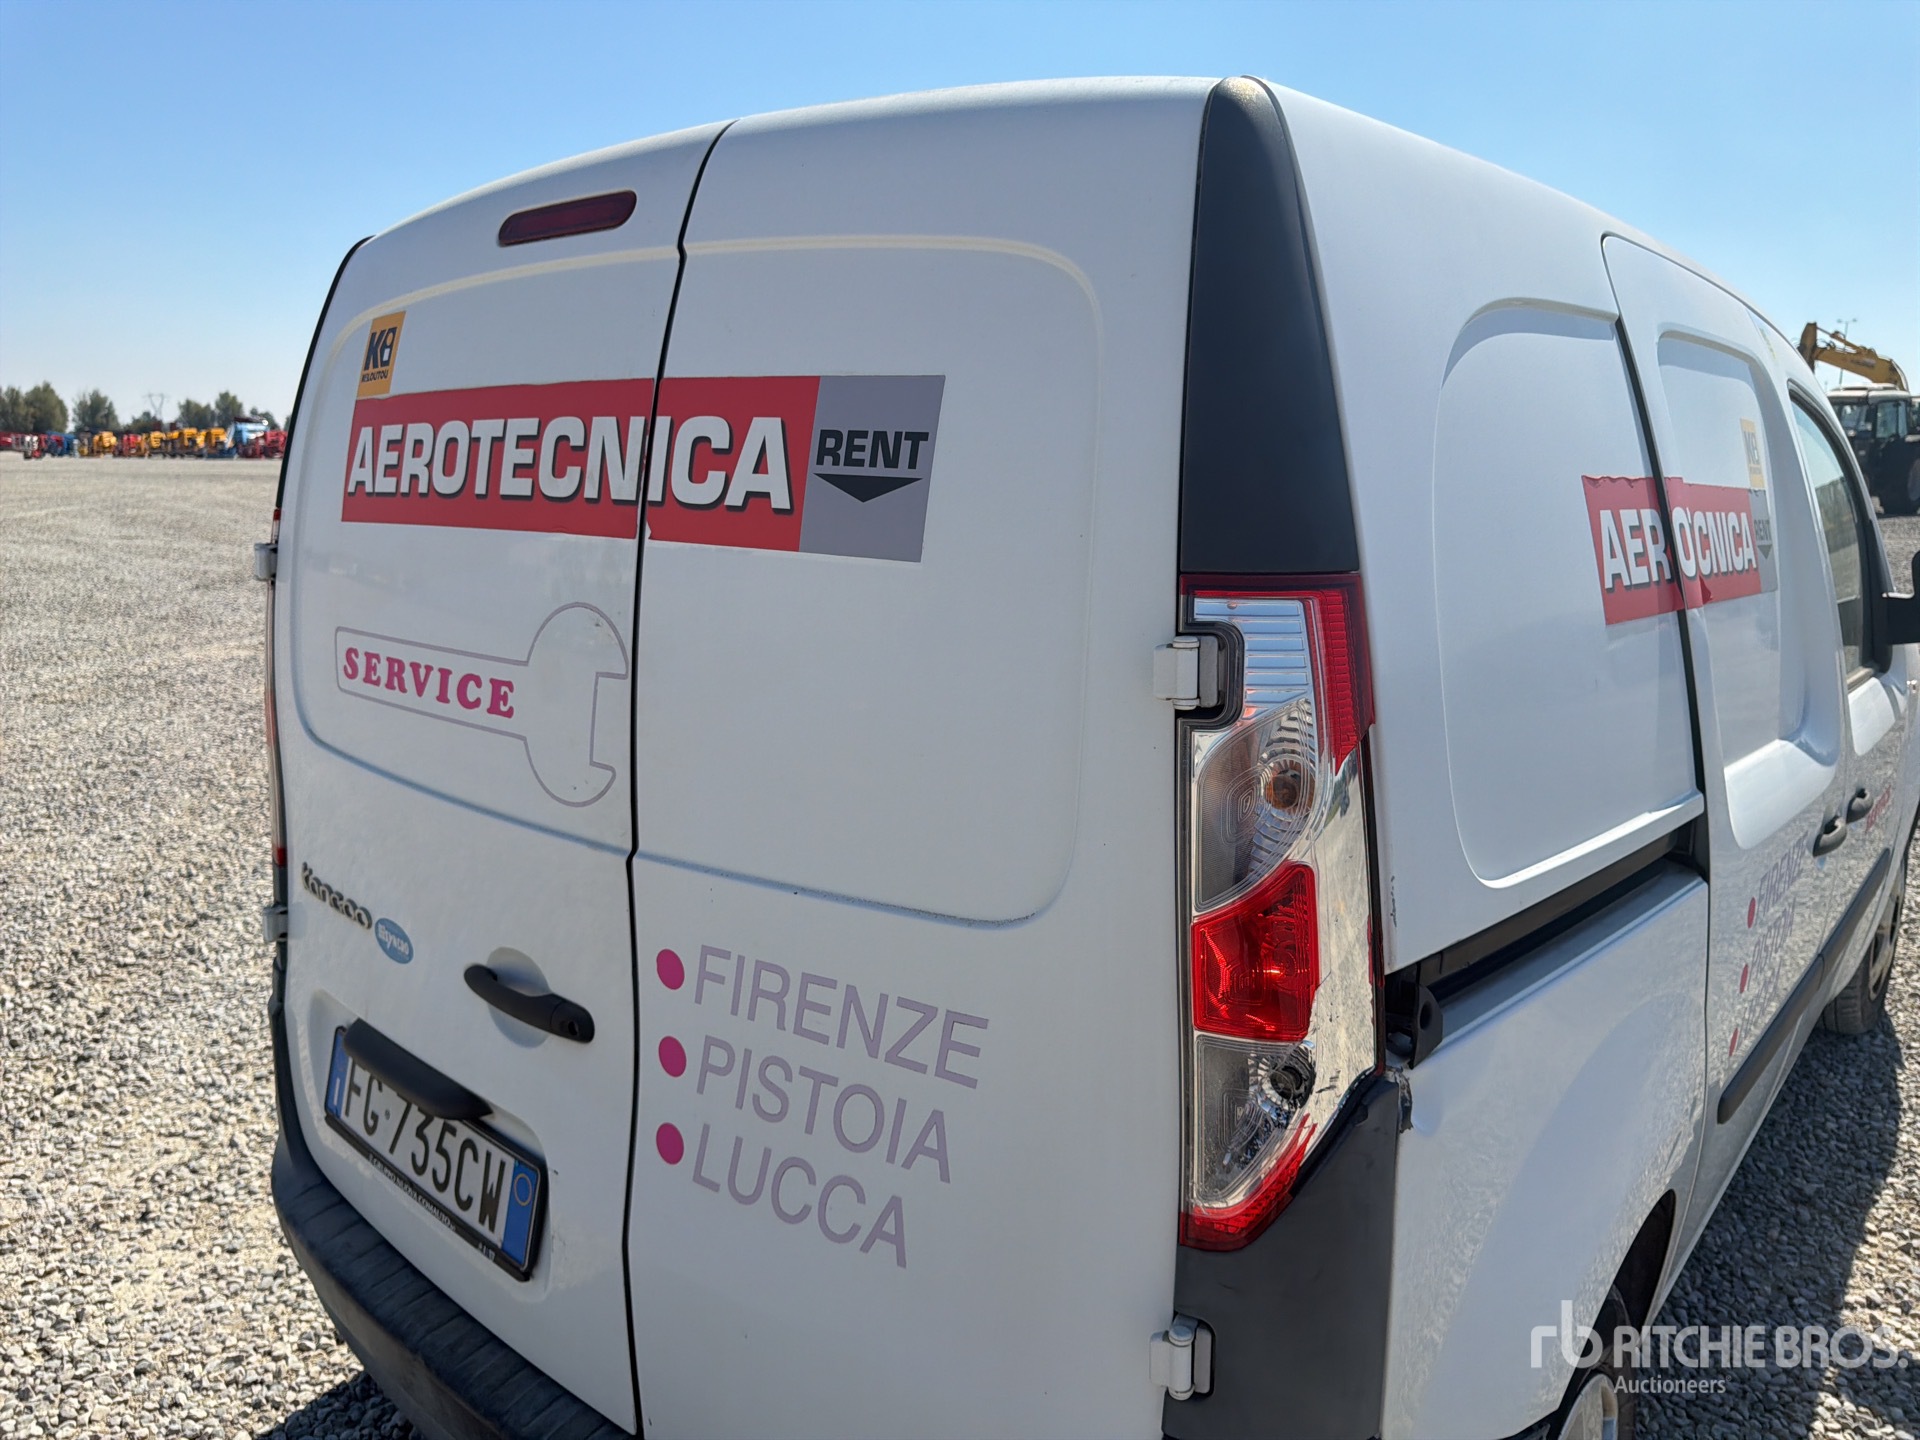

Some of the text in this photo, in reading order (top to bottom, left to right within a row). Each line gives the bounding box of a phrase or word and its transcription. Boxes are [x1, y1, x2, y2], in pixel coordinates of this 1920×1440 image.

[347, 415, 795, 515] AEROTECNICA
[816, 429, 930, 470] RENT
[343, 646, 515, 719] SERVICE
[694, 944, 990, 1090] FIRENZE
[696, 1034, 951, 1184] PISTOIA
[692, 1122, 907, 1269] LUCCA
